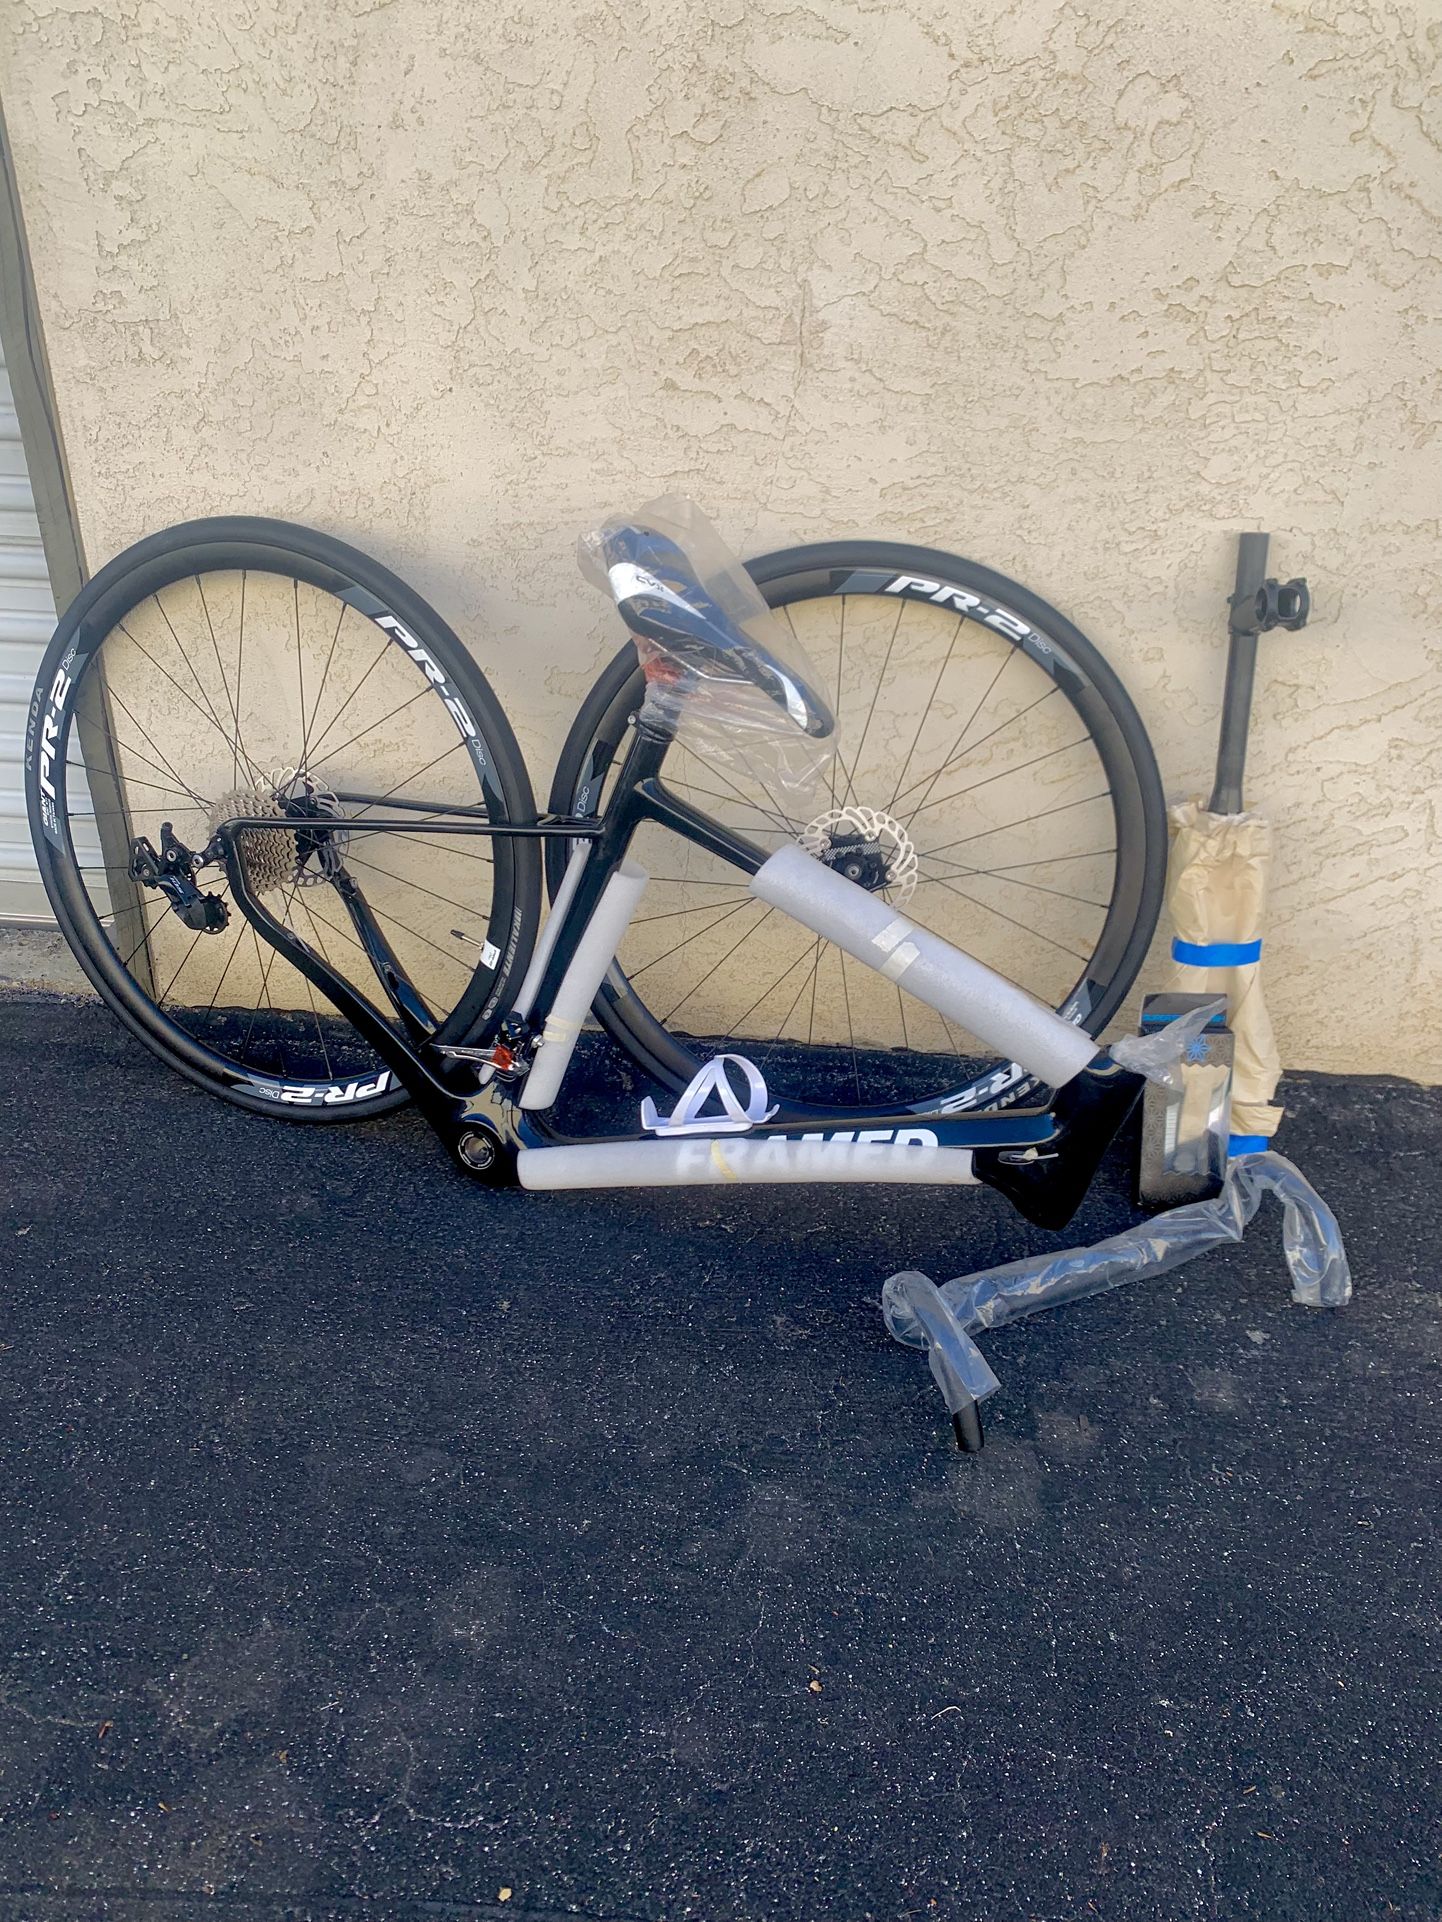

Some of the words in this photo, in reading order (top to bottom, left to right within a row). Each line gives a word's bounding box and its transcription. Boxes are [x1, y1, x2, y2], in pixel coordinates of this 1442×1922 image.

[884, 575, 1031, 641] PR-2
[1028, 632, 1052, 654] Disc
[25, 687, 44, 771] KENDA
[40, 668, 72, 801] PR-2
[61, 648, 77, 671] Disc
[375, 615, 476, 738] PR-2
[471, 739, 487, 766] Disc
[576, 786, 590, 812] Disc
[258, 1087, 280, 1100] Disc
[281, 1070, 391, 1103] PR-2
